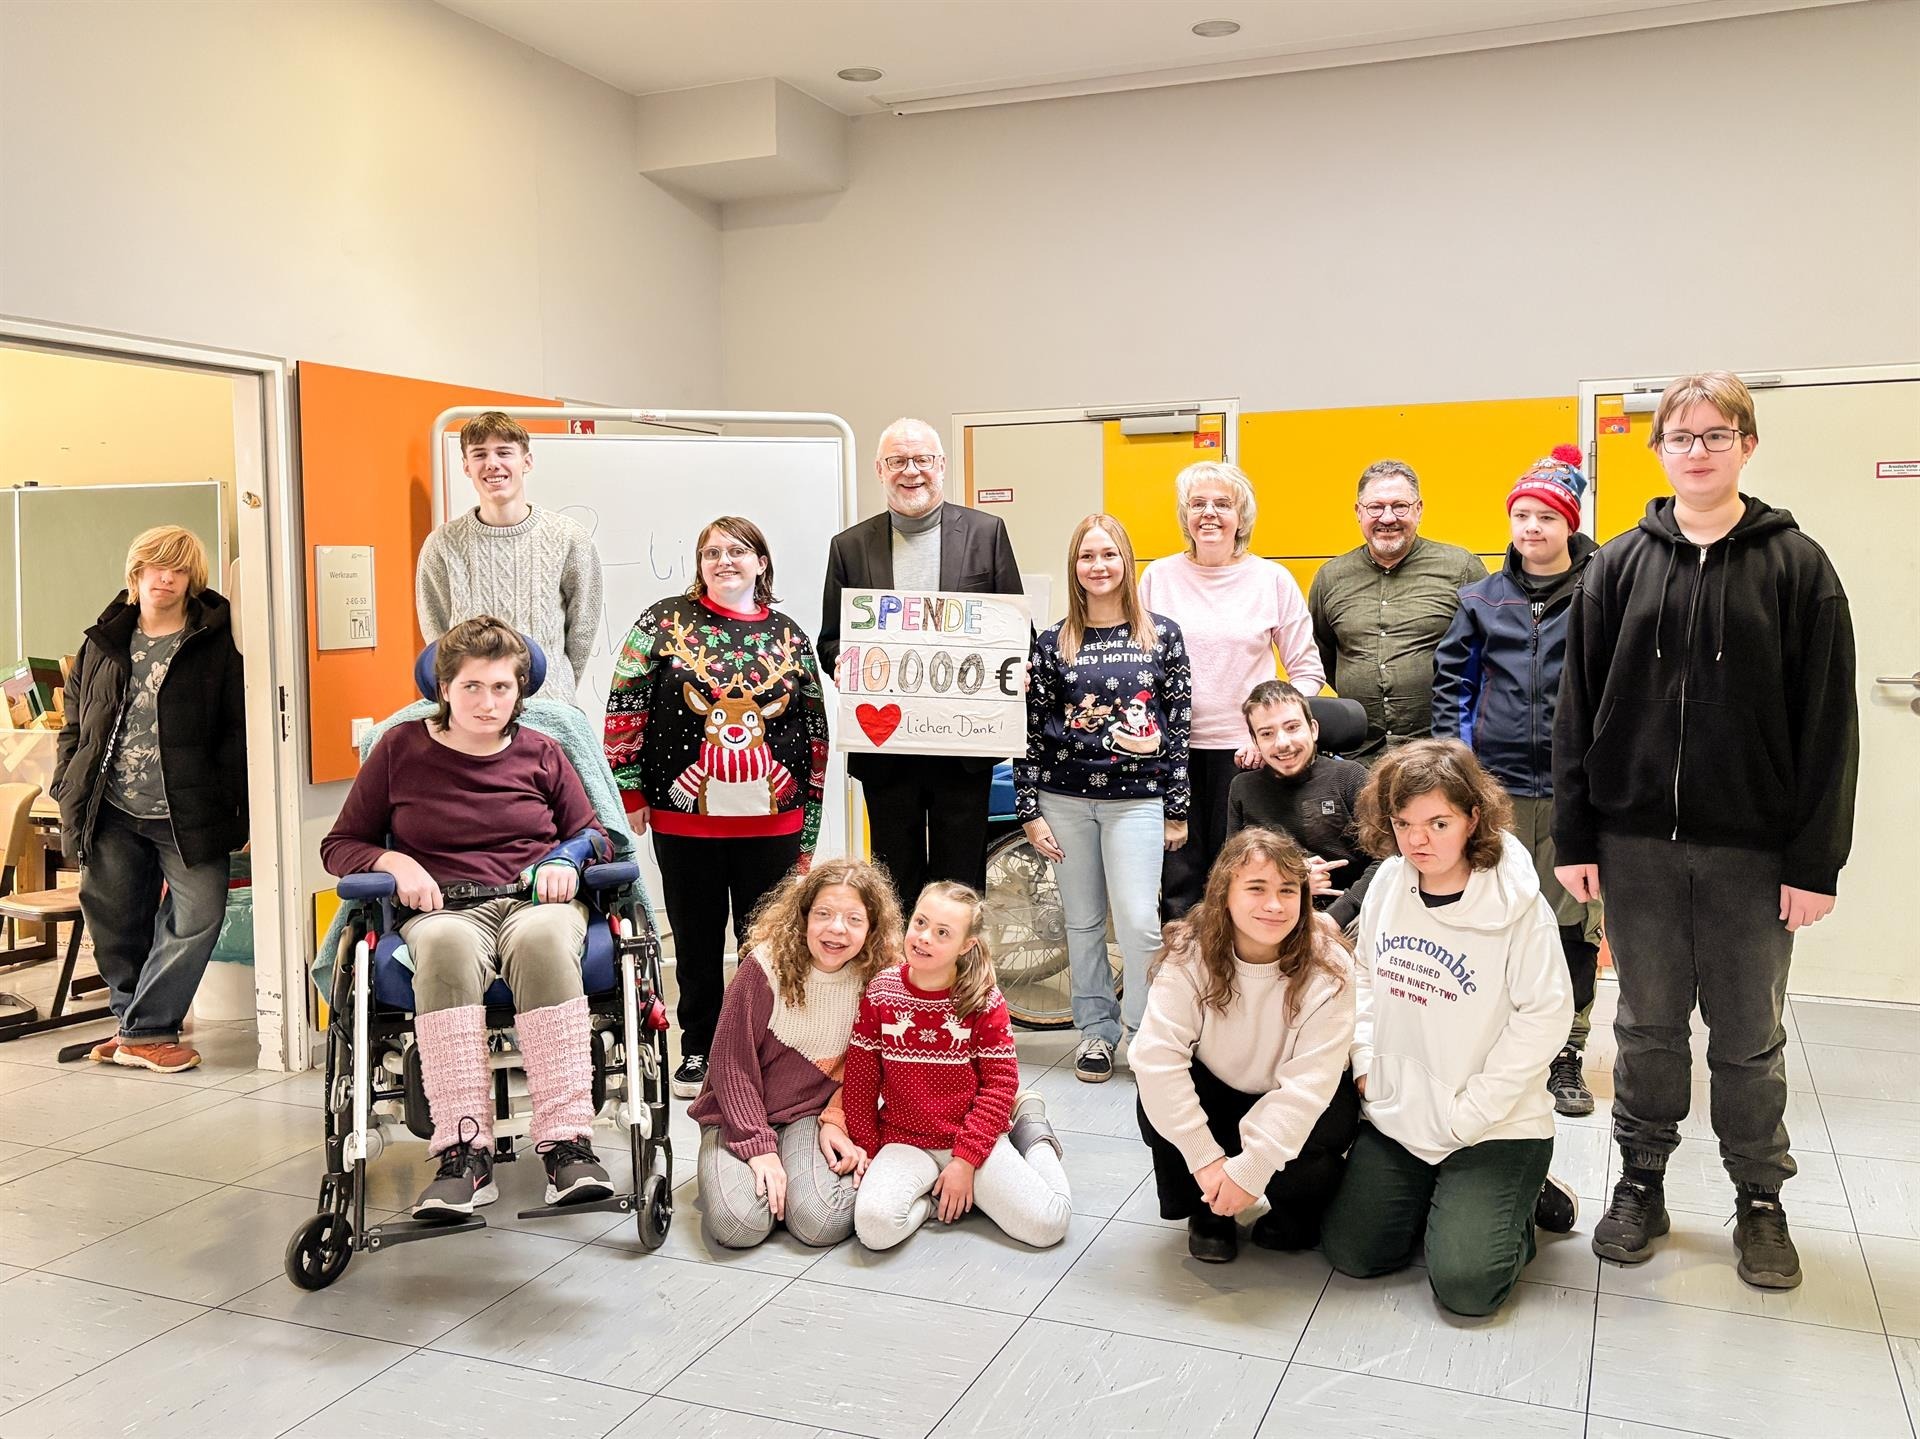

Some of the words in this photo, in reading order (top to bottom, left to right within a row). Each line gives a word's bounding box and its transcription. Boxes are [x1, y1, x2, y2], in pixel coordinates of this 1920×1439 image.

[329, 571, 359, 579] Werkraum
[850, 594, 983, 635] SPENDE
[1083, 641, 1103, 652] SEE
[1107, 640, 1124, 649] ME
[1102, 653, 1153, 664] HATING
[841, 645, 986, 696] 10.000
[995, 656, 1022, 697] €
[1389, 956, 1441, 980] ESTABLISHED
[1390, 986, 1406, 999] NEW
[1407, 992, 1428, 1007] YORK
[1407, 976, 1458, 1002] NINETY-TWO
